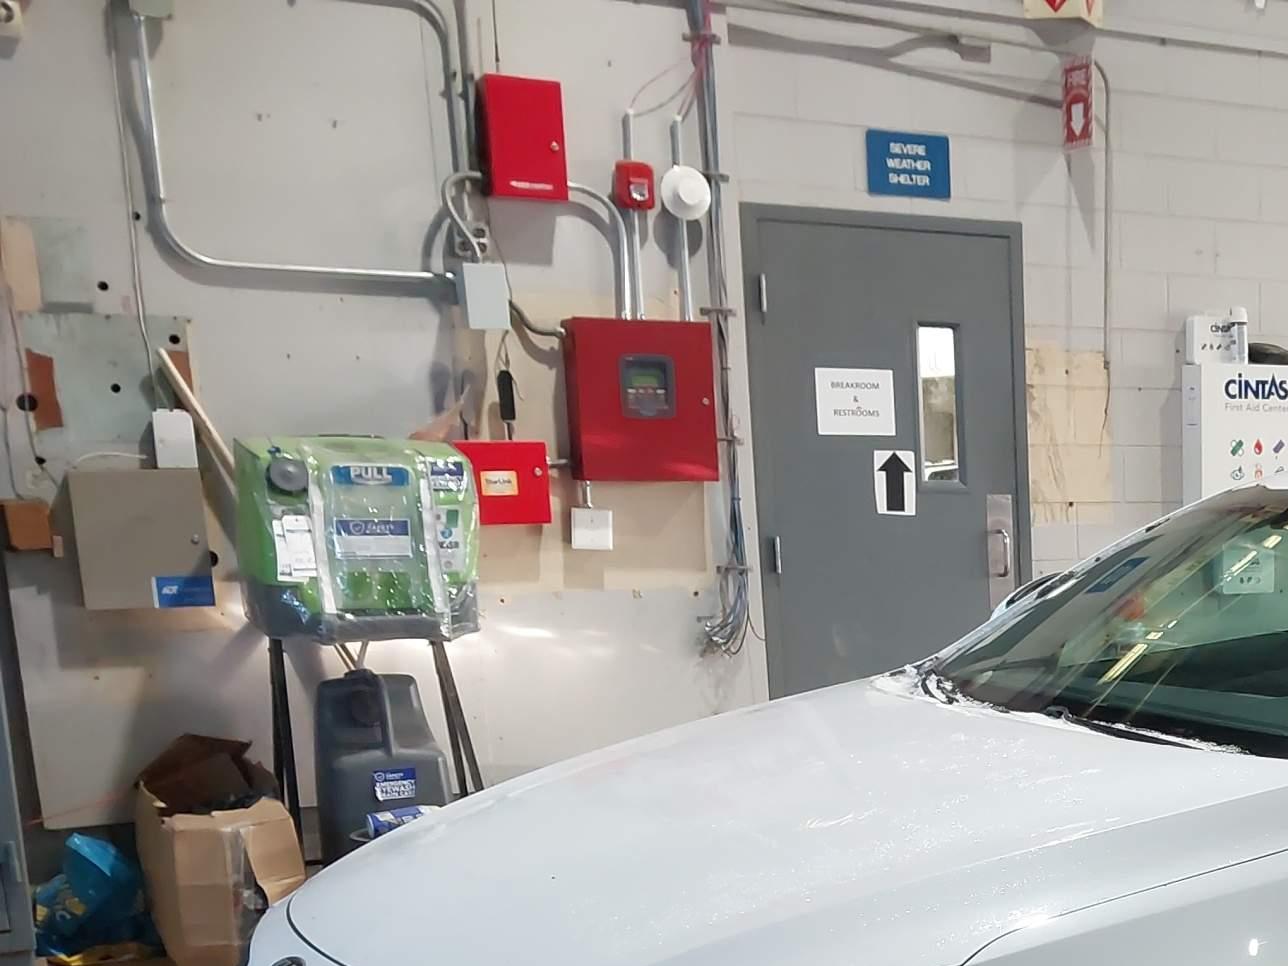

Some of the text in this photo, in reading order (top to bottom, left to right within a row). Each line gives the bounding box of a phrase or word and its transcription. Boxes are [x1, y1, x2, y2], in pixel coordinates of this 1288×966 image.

[889, 142, 926, 156] SEVERE
[886, 157, 931, 171] WEATHER
[888, 172, 930, 187] SHELTER
[830, 381, 880, 389] BREAKROOM
[833, 409, 880, 417] RESTROOMS
[1224, 403, 1288, 412] First Aid Center
[350, 466, 393, 480] PULL
